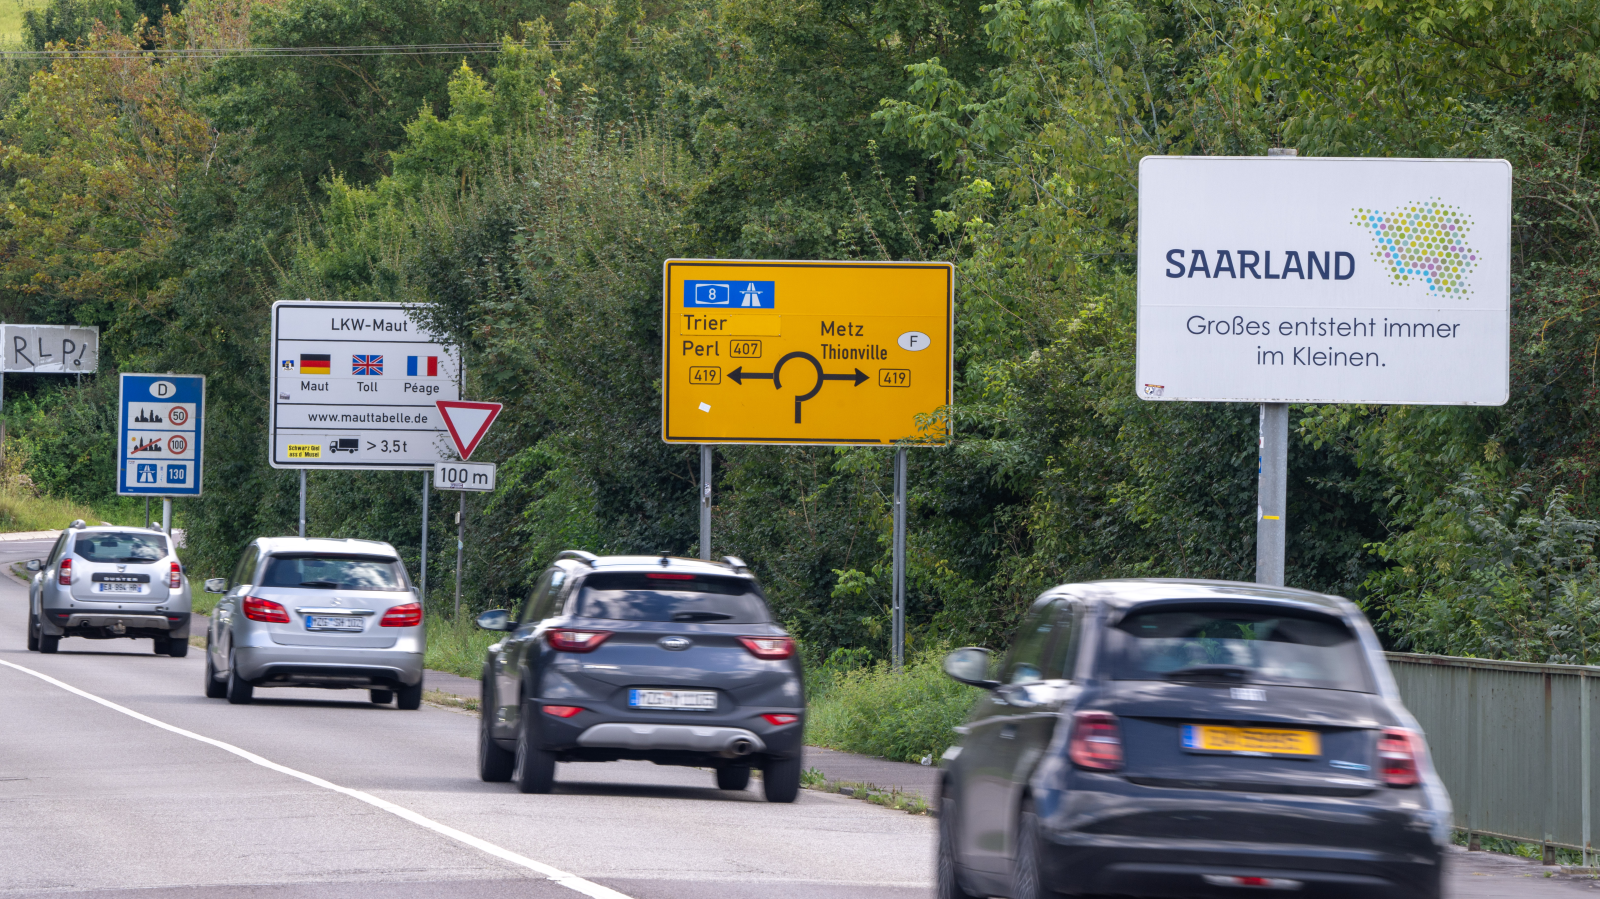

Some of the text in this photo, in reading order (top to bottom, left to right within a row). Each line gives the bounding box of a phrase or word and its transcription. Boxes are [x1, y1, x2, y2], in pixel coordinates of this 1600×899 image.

[1165, 248, 1356, 281] SAARLAND
[708, 287, 717, 300] 8
[331, 317, 408, 332] LKW-Maut
[683, 314, 728, 331] Trier
[820, 320, 864, 337] Metz
[1186, 315, 1461, 338] Großes entsteht immer
[909, 335, 919, 348] F
[682, 340, 720, 357] Perl
[733, 342, 759, 355] 407
[820, 343, 888, 361] Thionville
[1257, 345, 1386, 368] im Kleinen.
[694, 369, 717, 382] 419
[883, 371, 906, 385] 419
[158, 383, 168, 396] D
[300, 380, 329, 392] Maut
[356, 381, 378, 392] Toll
[404, 382, 440, 396] Péage
[172, 411, 185, 421] 50
[307, 412, 428, 424] www.mauttabelle.de
[171, 440, 184, 450] 100
[169, 468, 185, 480] 130
[440, 467, 488, 485] 100 m
